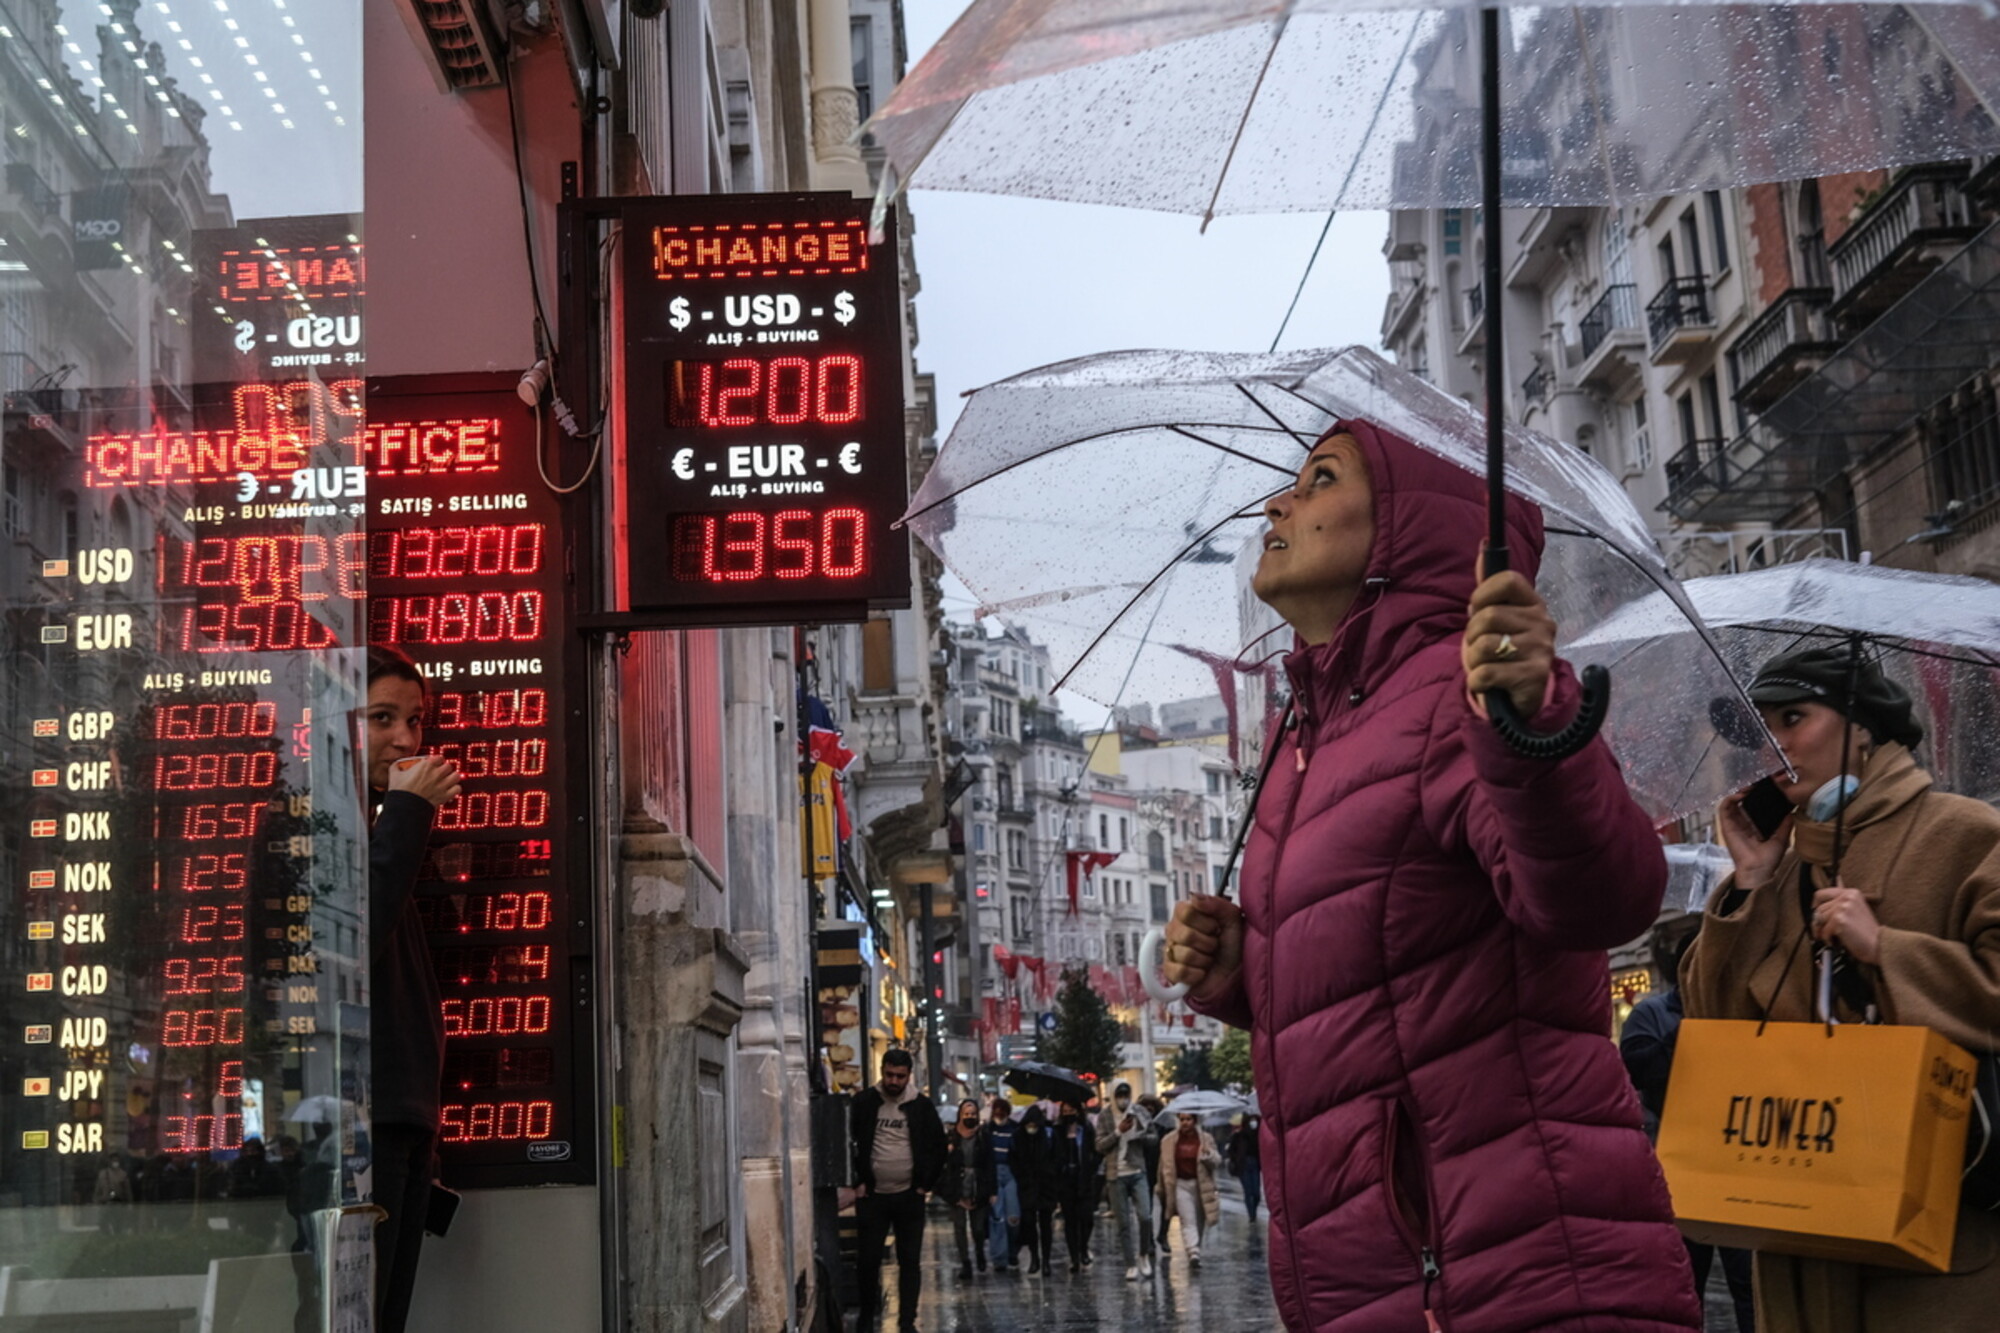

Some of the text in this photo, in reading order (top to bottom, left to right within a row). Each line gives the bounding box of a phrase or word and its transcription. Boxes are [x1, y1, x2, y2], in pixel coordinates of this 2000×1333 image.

[663, 234, 850, 266] CHANGE
[669, 296, 691, 331] $
[724, 294, 800, 326] USD
[834, 291, 856, 326] $
[707, 331, 743, 347] ALIŞ
[757, 330, 819, 343] BUYING
[96, 436, 299, 477] CHANGE
[671, 448, 695, 479] €
[728, 445, 806, 478] EUR
[838, 442, 861, 474] €
[381, 498, 432, 516] SATIŞ
[449, 494, 527, 511] SELLING
[710, 483, 747, 499] ALIŞ
[761, 482, 824, 496] BUYING
[184, 506, 224, 525] ALIŞ
[78, 548, 133, 585] USD
[76, 614, 132, 650] EUR
[144, 674, 184, 692] ALIŞ
[201, 669, 272, 686] BUYING
[470, 658, 542, 675] BUYING
[67, 711, 114, 741] GBP
[66, 761, 111, 792] CHF
[65, 811, 111, 841] DKK
[64, 862, 112, 893] NOK
[62, 913, 105, 944] SEK
[62, 965, 108, 996] CAD
[60, 1017, 106, 1048] AUD
[59, 1069, 104, 1101] JPY
[58, 1122, 102, 1154] SAR
[1723, 1095, 1838, 1153] FLOWER
